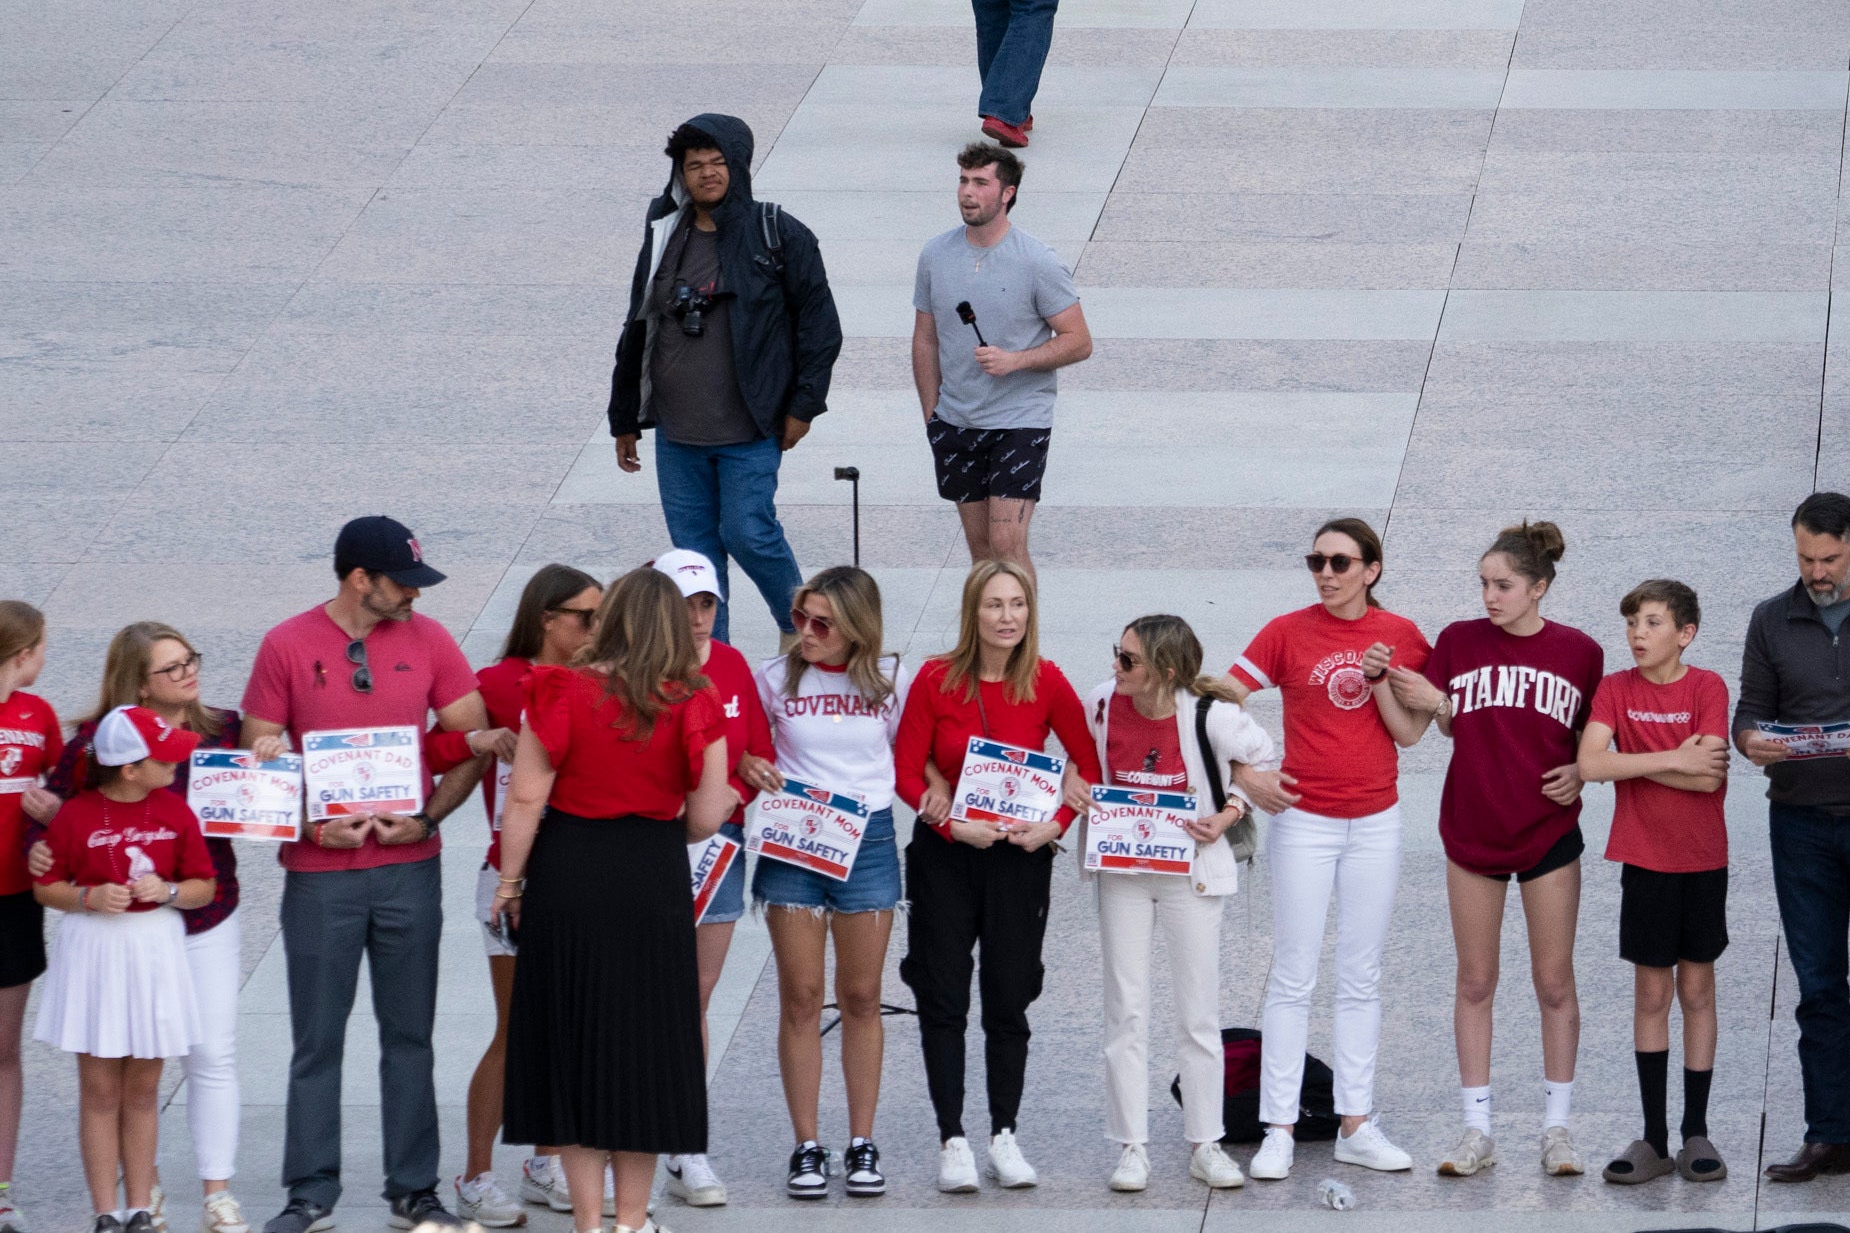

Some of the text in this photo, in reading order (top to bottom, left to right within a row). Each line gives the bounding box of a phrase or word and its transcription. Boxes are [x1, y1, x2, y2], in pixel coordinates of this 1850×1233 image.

[1766, 733, 1833, 745] OVENANT
[310, 750, 412, 774] COVENANT DAD
[192, 770, 299, 799] COVENANT MOM
[964, 762, 1056, 797] COVENANT MOM
[1127, 771, 1174, 786] COVENANT
[320, 784, 411, 802] GUN SAFETY
[201, 806, 293, 825] GUN SAFETY
[762, 798, 861, 840] COVENANT MOM
[966, 793, 1048, 822] GUN SAFETY
[1090, 807, 1187, 828] COVENANT MO
[762, 827, 848, 864] GUN SAFETY
[1098, 840, 1188, 860] GUN SAFETY
[692, 839, 722, 890] SAFETY
